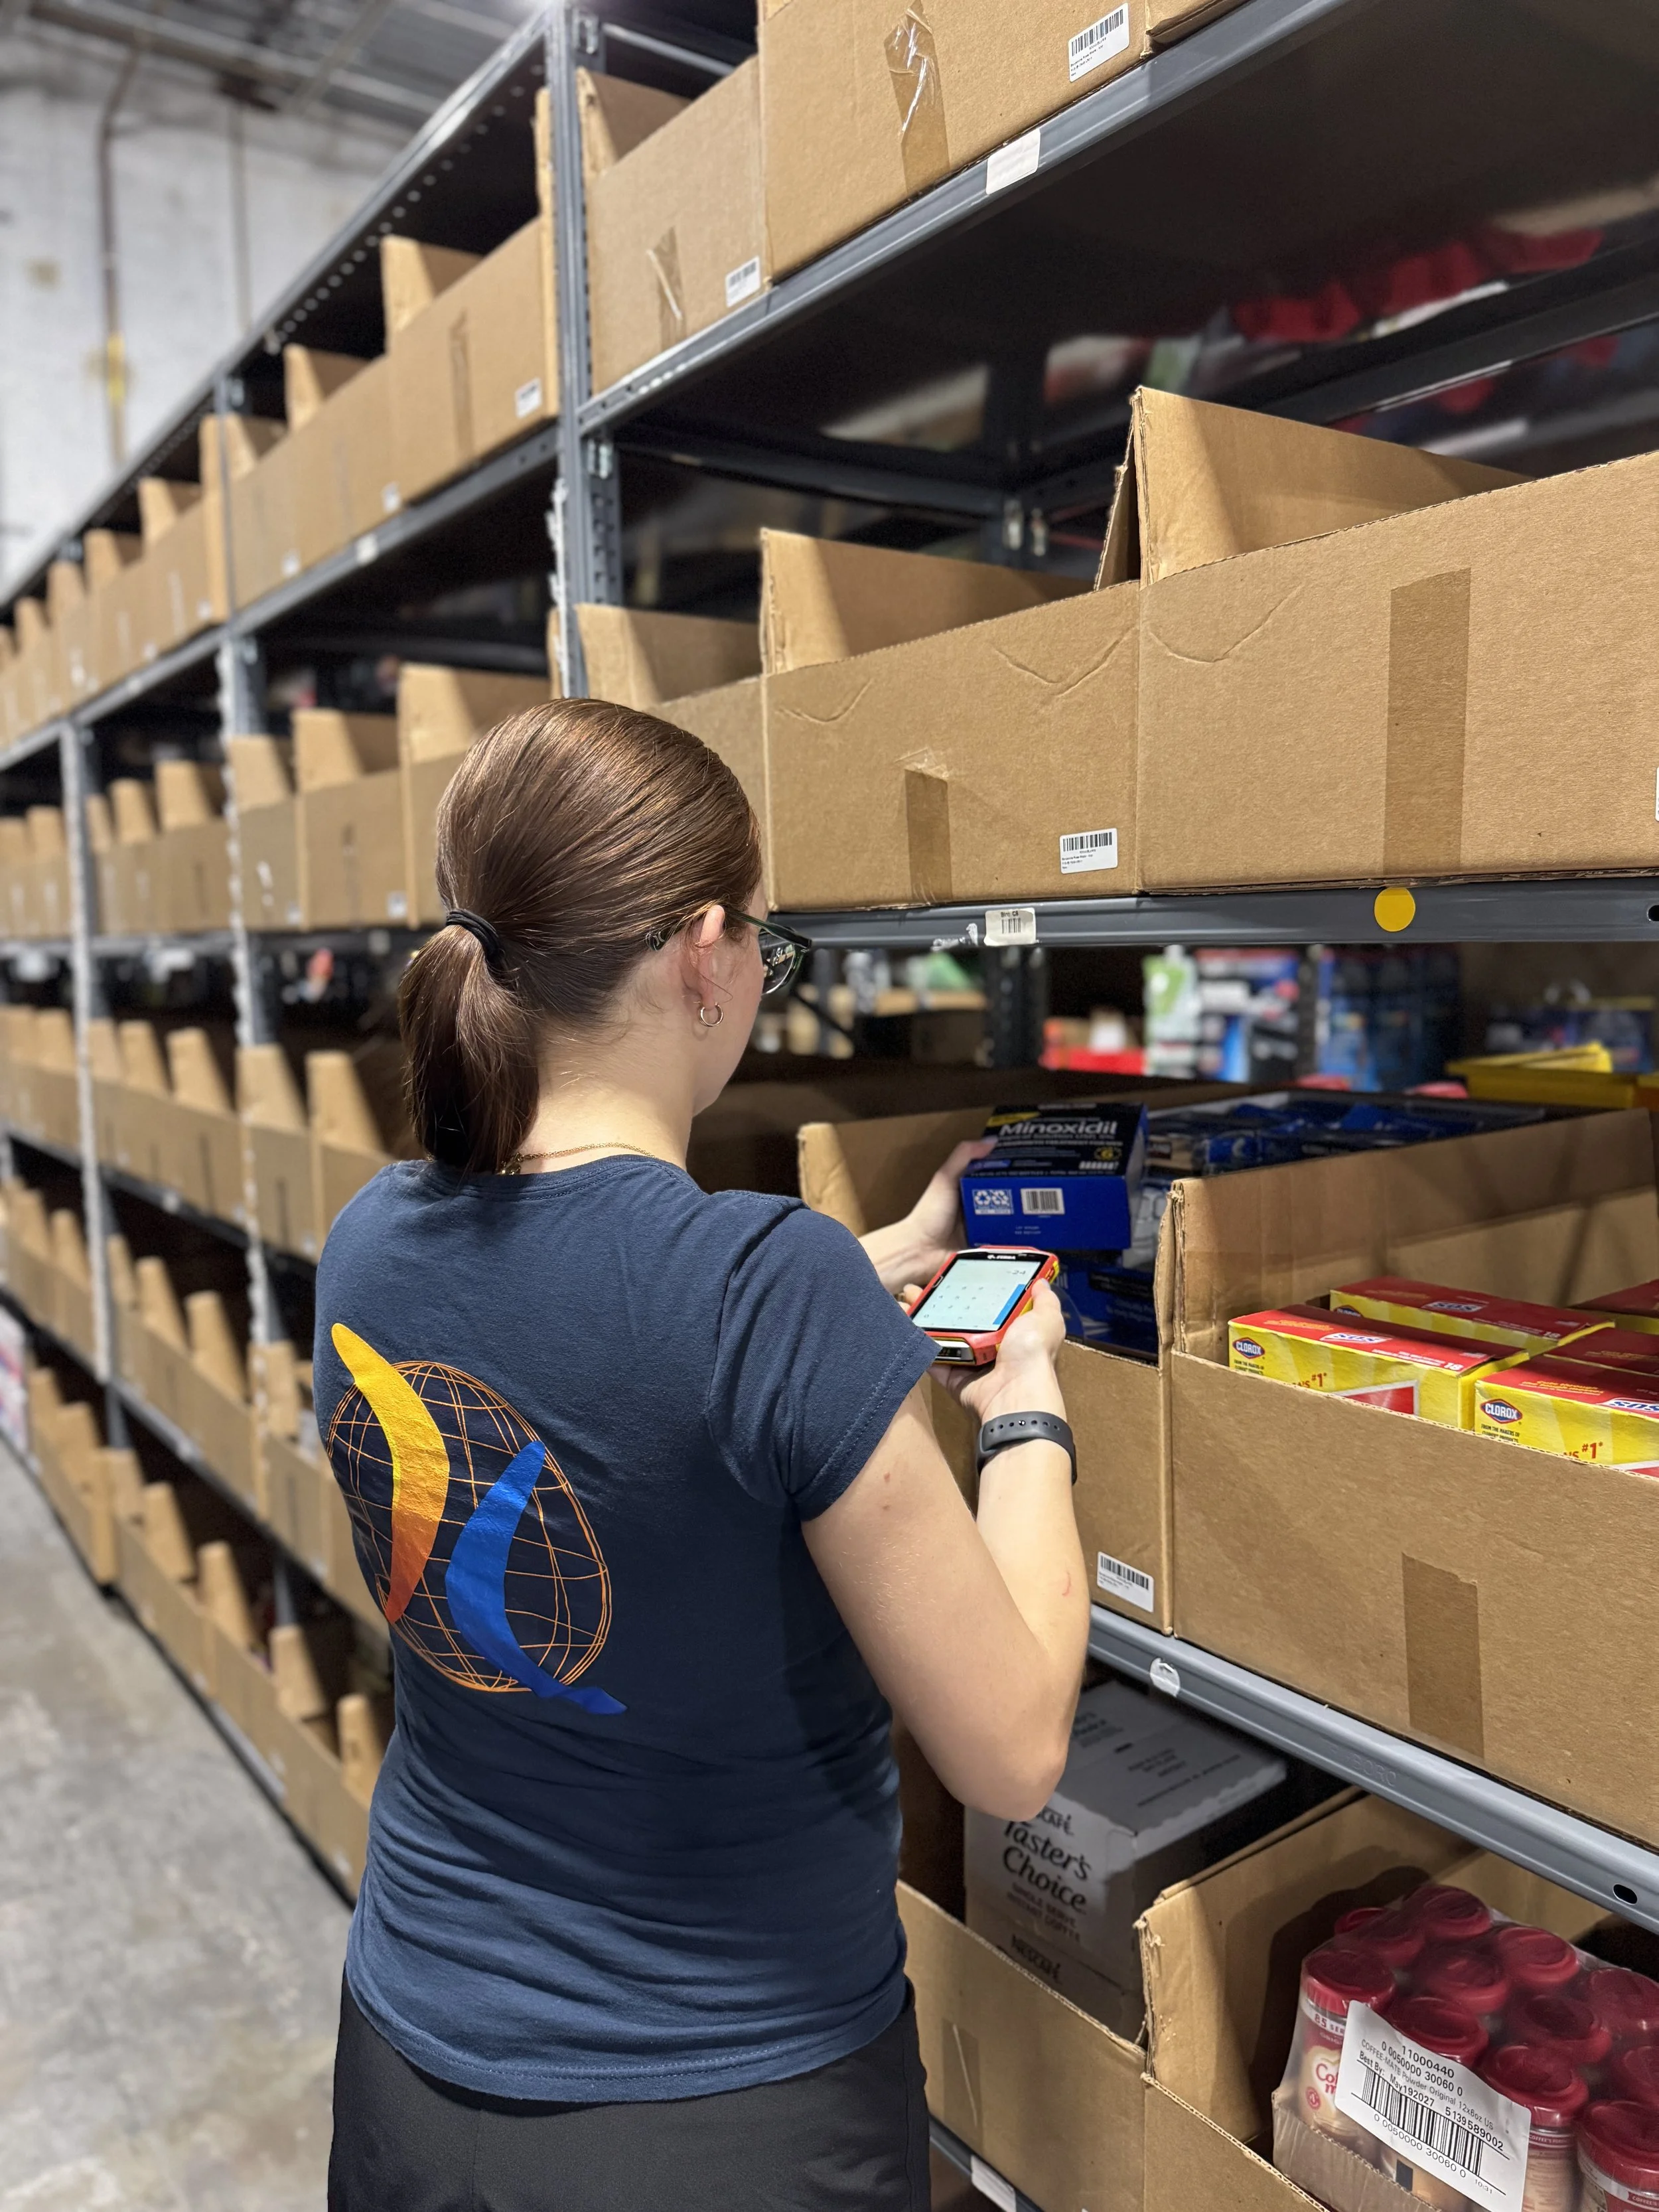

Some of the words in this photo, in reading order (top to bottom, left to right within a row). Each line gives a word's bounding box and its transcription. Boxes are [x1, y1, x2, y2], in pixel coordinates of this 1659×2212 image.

[999, 1120, 1118, 1136] Minoxidil
[1236, 1341, 1262, 1355] CLOROX
[1444, 1362, 1464, 1370] 18
[1484, 1403, 1518, 1420] CLOROX
[1003, 1820, 1092, 1882] Taster's
[1003, 1846, 1088, 1915] Choice
[1314, 2013, 1327, 2028] 85
[1359, 2050, 1374, 2068] Best
[1374, 2061, 1385, 2076] By:
[1382, 2041, 1387, 2051] 0
[1388, 2046, 1421, 2077] 0050000
[1425, 2071, 1454, 2092] 30060
[1457, 2087, 1463, 2096] 0
[1402, 2045, 1455, 2079] 11000440
[1362, 2039, 1401, 2075] COFFEE-MATE
[1402, 2071, 1427, 2090] Powder
[1429, 2086, 1456, 2104] Original
[1484, 2117, 1494, 2130] US
[1374, 2113, 1380, 2122] 0
[1382, 2119, 1423, 2151] 0050000
[1425, 2148, 1457, 2172] 30060
[1460, 2169, 1466, 2177] 0
